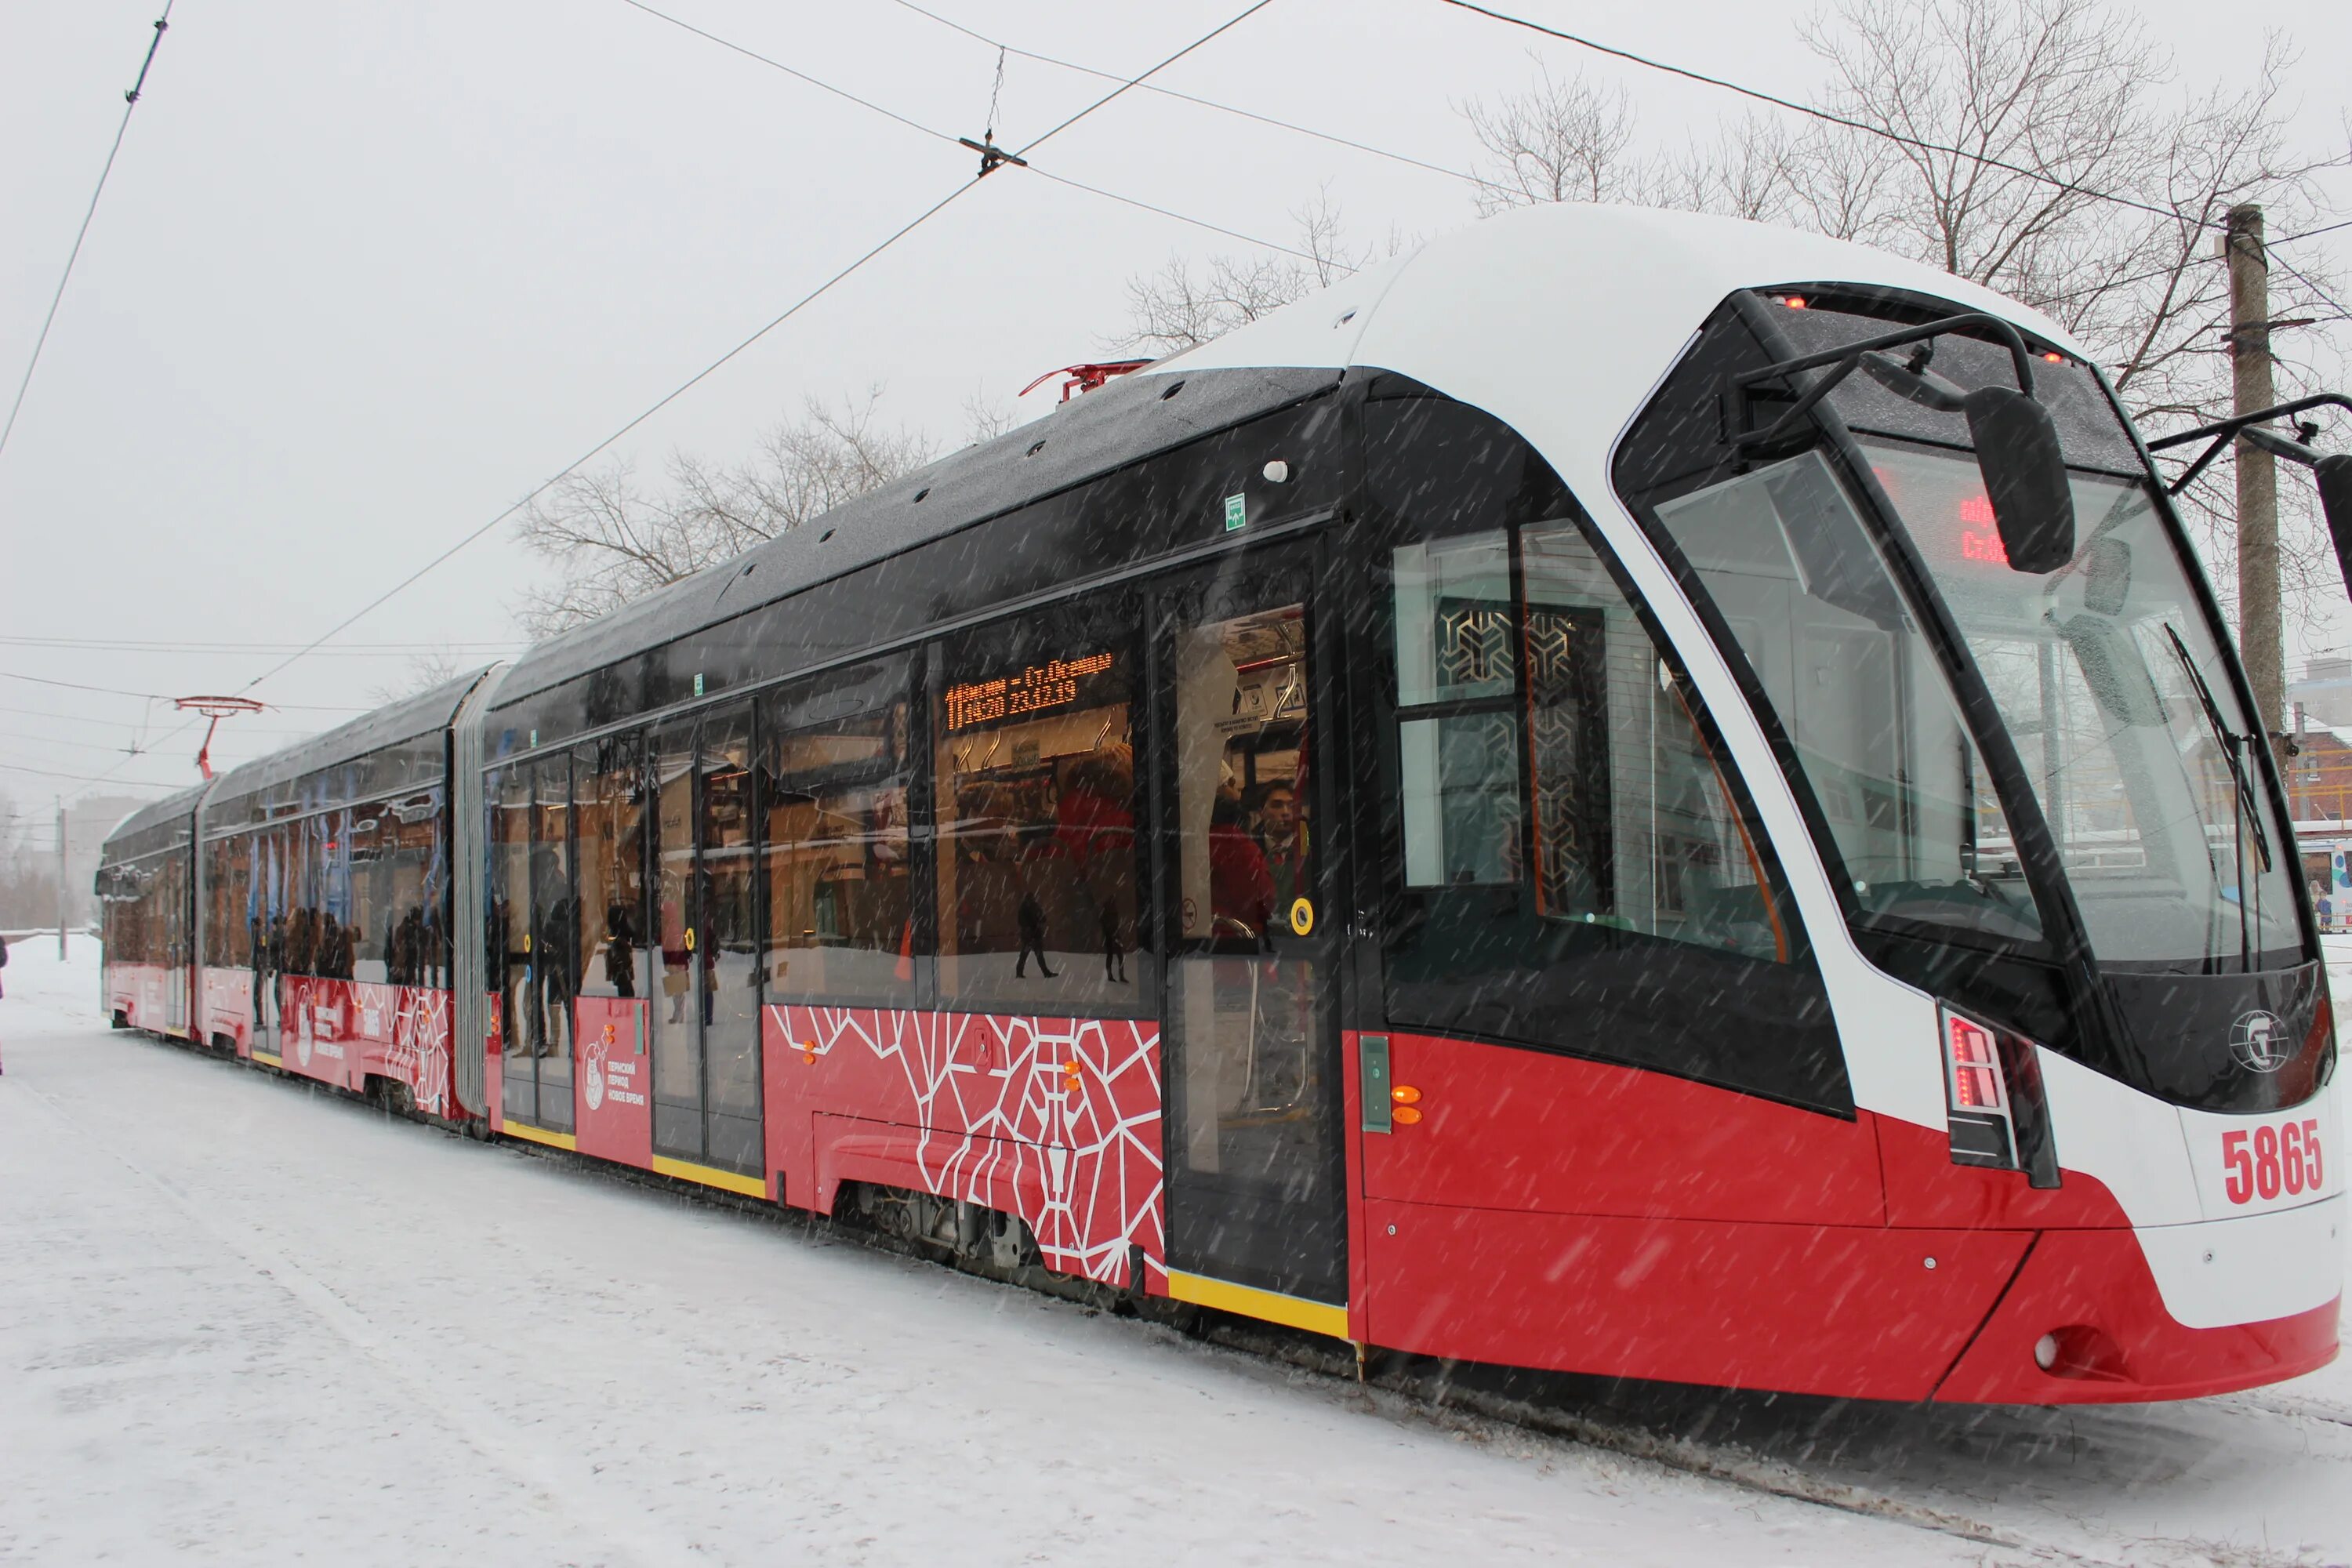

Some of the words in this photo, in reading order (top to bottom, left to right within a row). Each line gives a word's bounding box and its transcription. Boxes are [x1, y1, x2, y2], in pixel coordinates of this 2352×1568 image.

[946, 684, 963, 730] 11
[965, 696, 1005, 724] 14:20
[1010, 680, 1076, 714] 23.12.19
[608, 1061, 636, 1076] ПЕРМСКИЙ
[608, 1074, 629, 1089] ПЕРИОД
[608, 1089, 626, 1103] НОВОЕ
[626, 1092, 644, 1105] ВРЕМЯ
[2222, 1119, 2323, 1205] 5865
